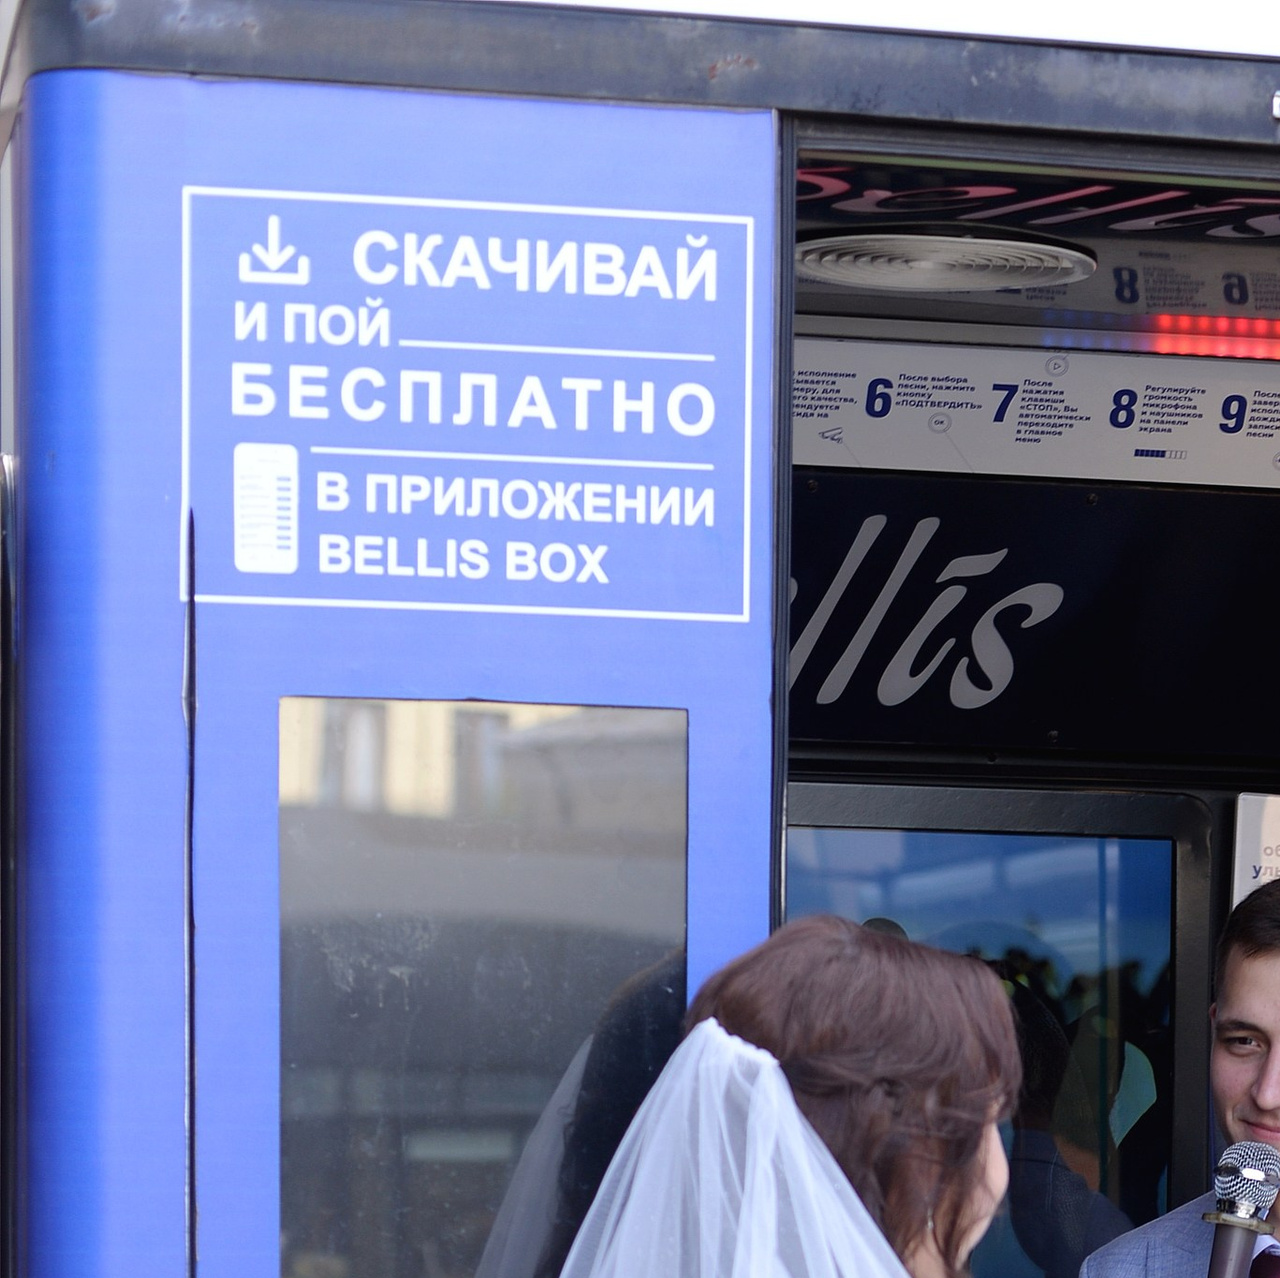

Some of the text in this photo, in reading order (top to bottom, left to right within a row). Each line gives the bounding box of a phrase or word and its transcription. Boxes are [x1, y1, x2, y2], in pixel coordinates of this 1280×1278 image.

[352, 230, 717, 301] СКАЧИВАЙ
[235, 297, 390, 346] И ПОЙ
[899, 374, 968, 384] После выбора
[1023, 379, 1053, 387] После
[897, 383, 975, 392] песни, нажмите
[1145, 384, 1207, 395] Регулируйте
[231, 362, 715, 436] БЕСПЛАТНО
[865, 377, 894, 418] 6
[896, 391, 933, 400] кнопку
[1144, 394, 1193, 402] громкость
[895, 399, 983, 410] «ПОДТВЕРДИТЬ»
[992, 383, 1019, 423] 7
[1109, 388, 1138, 429] 8
[1142, 402, 1198, 411] микрофона
[1064, 405, 1078, 413] Вы
[1219, 394, 1248, 434] 9
[1018, 413, 1091, 422] автоматически
[1149, 411, 1204, 419] наушников
[1017, 421, 1074, 429] переходите
[1138, 426, 1173, 434] экрана
[317, 472, 350, 511] В
[365, 473, 715, 527] ПРИЛОЖЕНИИ
[318, 534, 609, 584] BELLIS BOX
[788, 514, 1064, 709] llis
